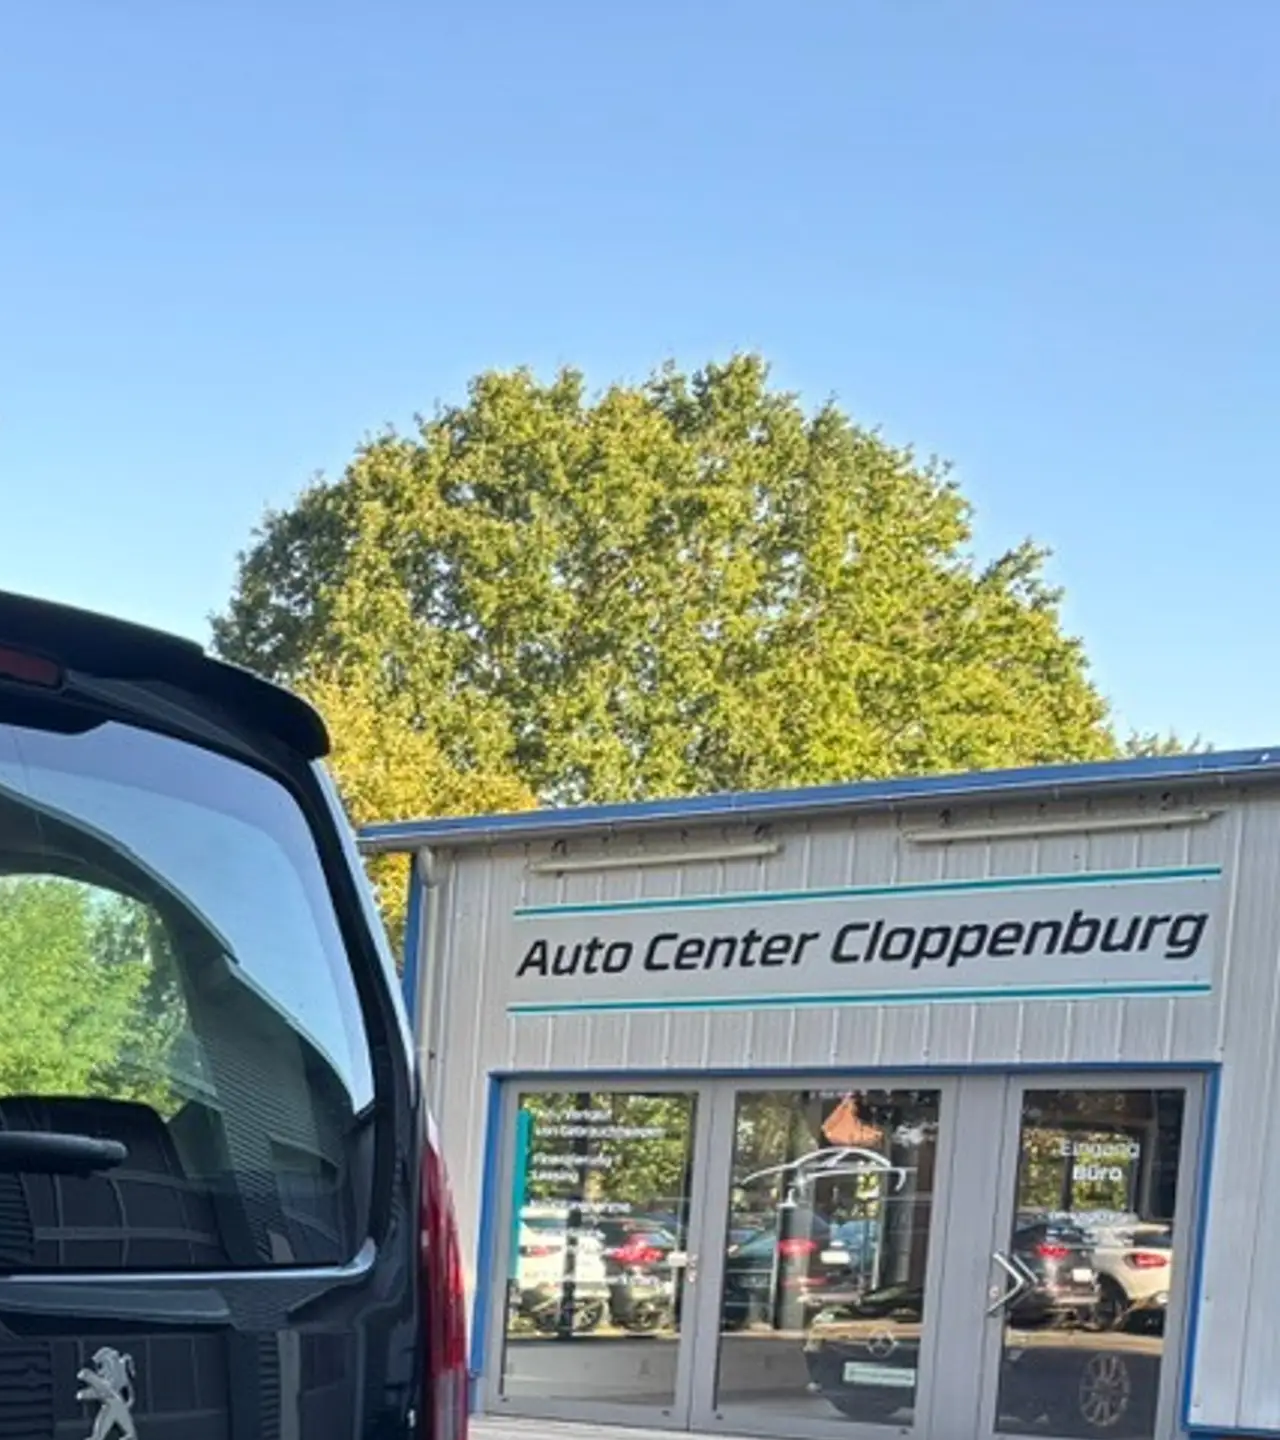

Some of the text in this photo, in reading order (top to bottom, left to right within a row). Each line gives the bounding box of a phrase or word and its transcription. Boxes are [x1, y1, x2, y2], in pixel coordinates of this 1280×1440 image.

[515, 909, 1209, 978] Auto Center Cloppenburg
[1060, 1140, 1141, 1159] Eingang
[1072, 1164, 1124, 1181] Büro
